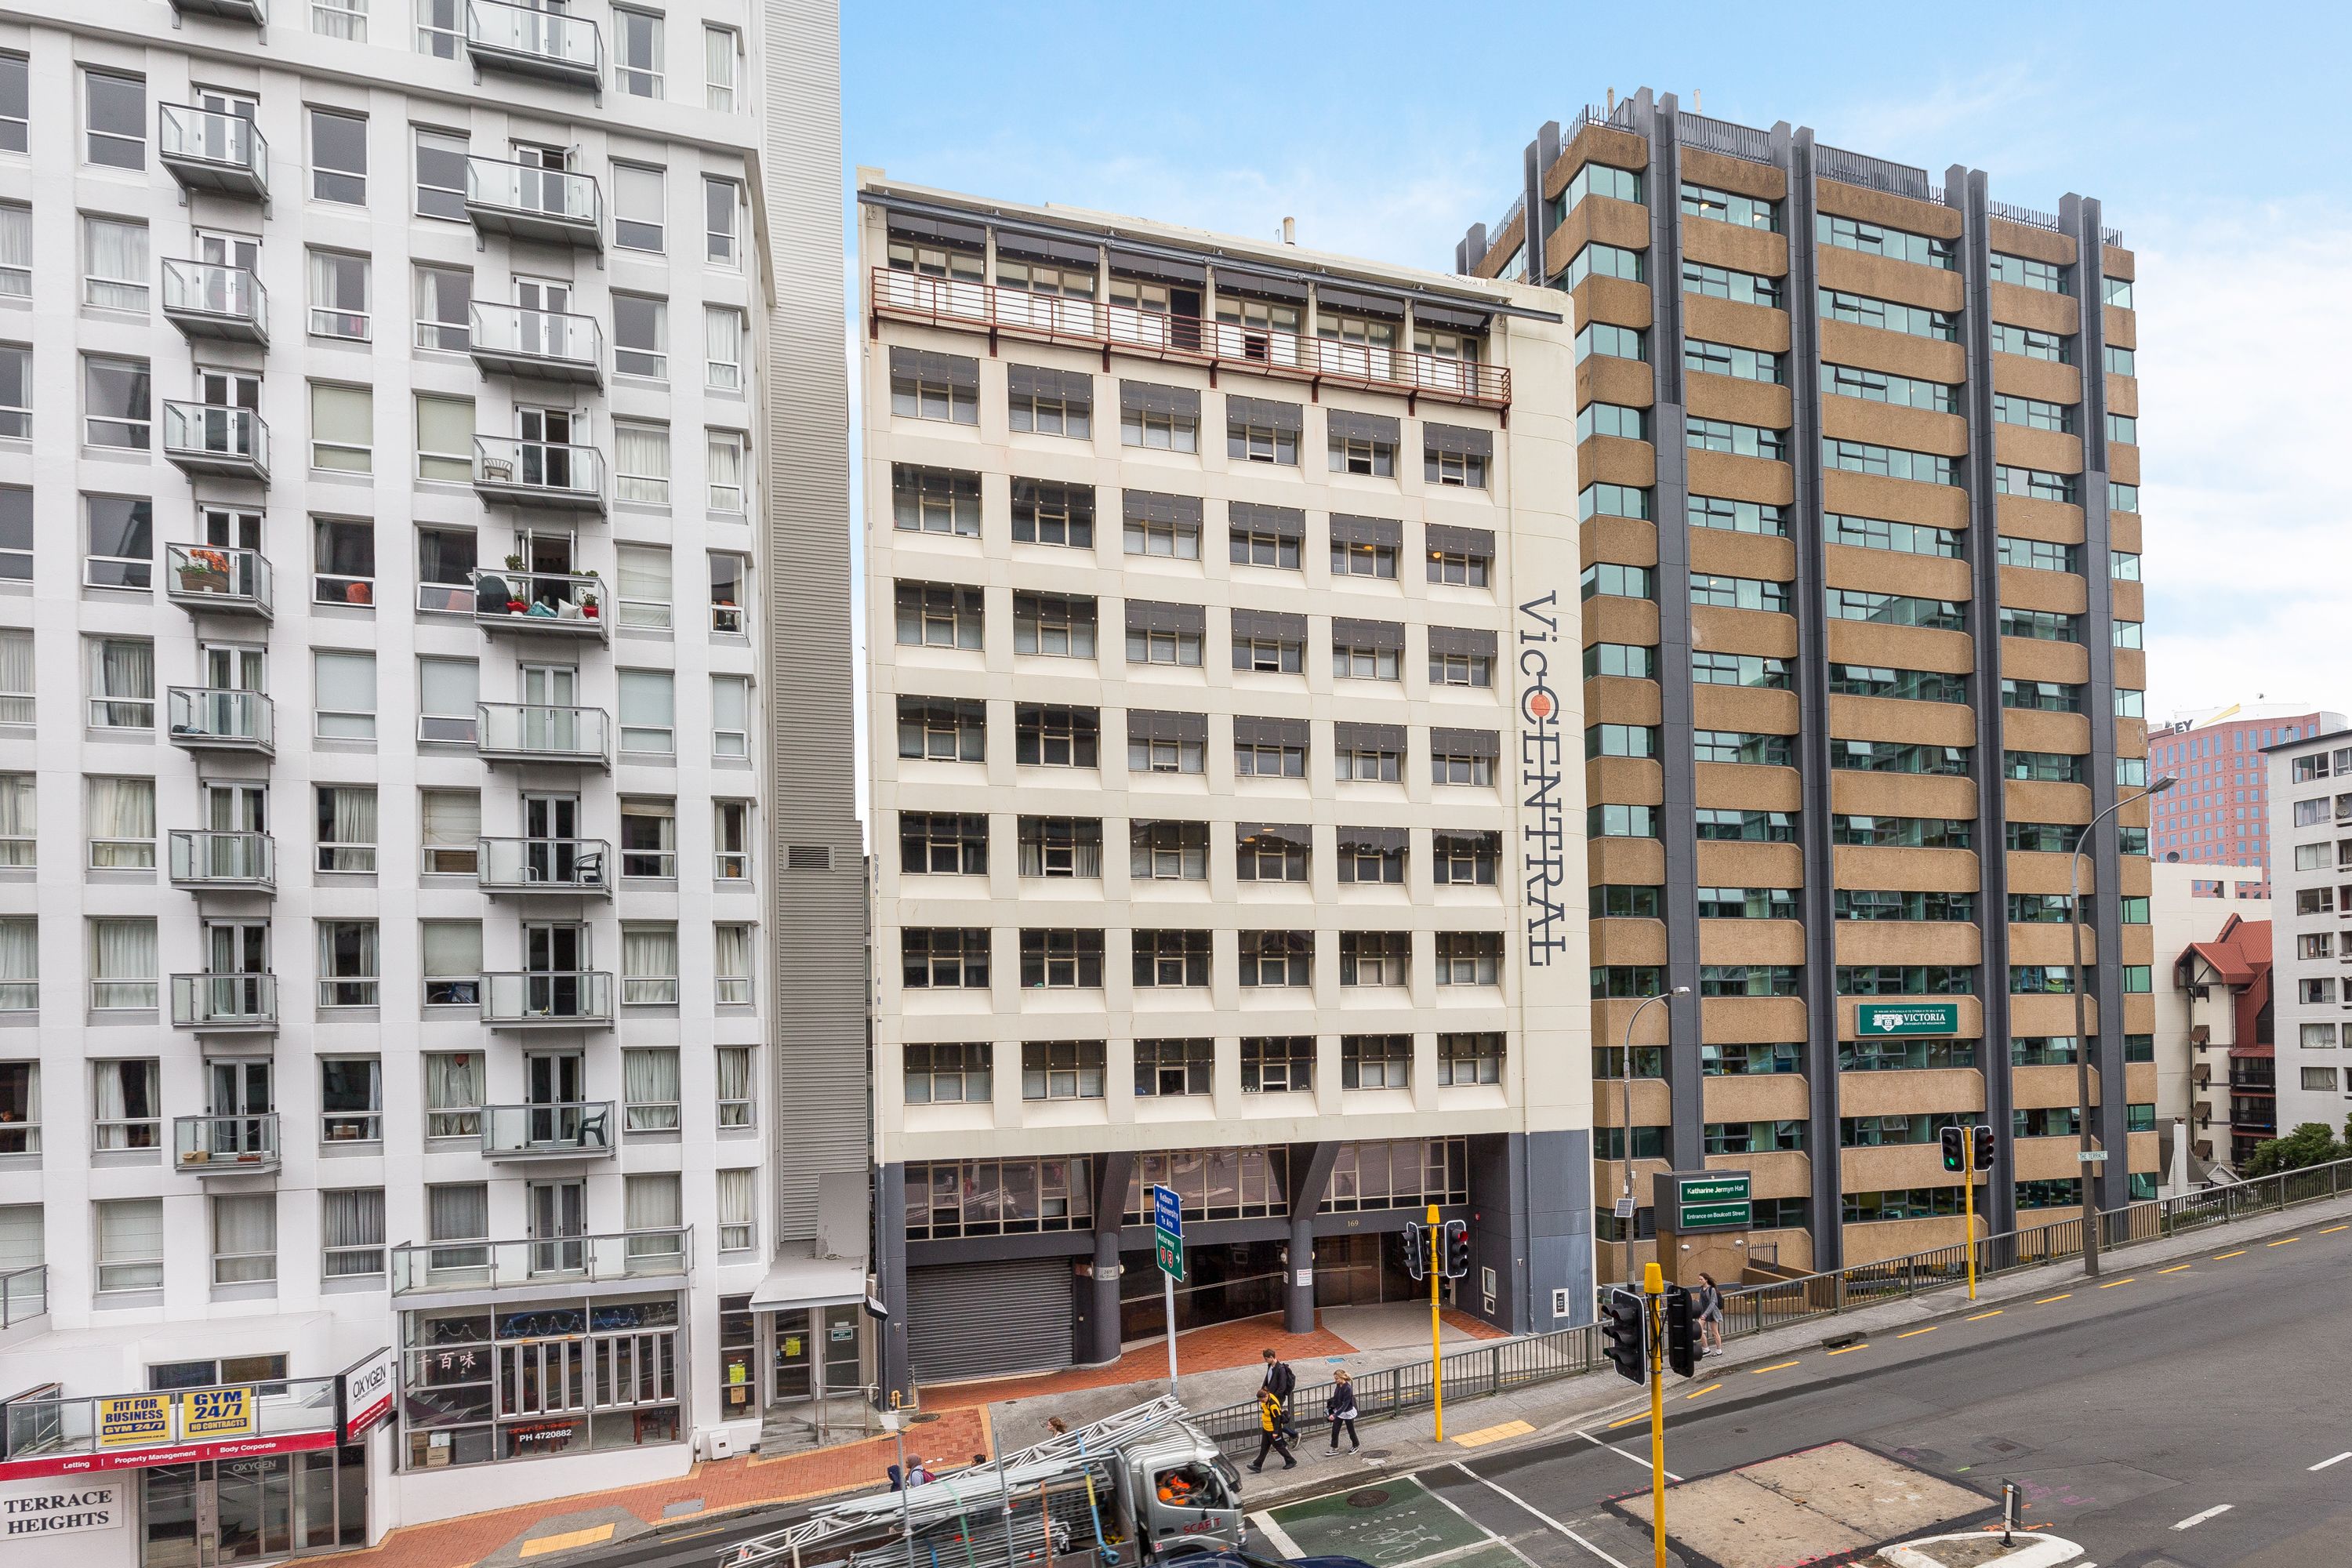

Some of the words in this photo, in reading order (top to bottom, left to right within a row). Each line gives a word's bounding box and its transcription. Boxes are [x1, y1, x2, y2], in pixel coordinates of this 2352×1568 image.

[2175, 719, 2193, 734] EY
[1160, 1192, 1173, 1205] Kelburn
[1160, 1206, 1178, 1221] University
[1158, 1232, 1174, 1250] Motorway
[416, 1351, 476, 1372] 千百味
[353, 1363, 386, 1398] OXYGEN
[113, 1399, 132, 1412] FIT
[135, 1399, 158, 1410] FOR
[194, 1390, 242, 1406] GYM
[105, 1409, 163, 1423] BUSINESS
[194, 1403, 242, 1420] 24/7
[105, 1425, 132, 1433] GYM
[191, 1422, 202, 1431] NO
[202, 1419, 245, 1430] CONTRACTS
[519, 1433, 532, 1443] PH
[535, 1428, 572, 1439] 4720882
[63, 1461, 90, 1469] Letting
[114, 1454, 147, 1465] Property
[148, 1450, 196, 1462] Management
[220, 1444, 239, 1454] Body
[240, 1442, 276, 1452] Corporate
[232, 1460, 276, 1472] OXYGEN
[4, 1490, 112, 1514] TERRACE
[7, 1511, 109, 1534] HEIGHTS
